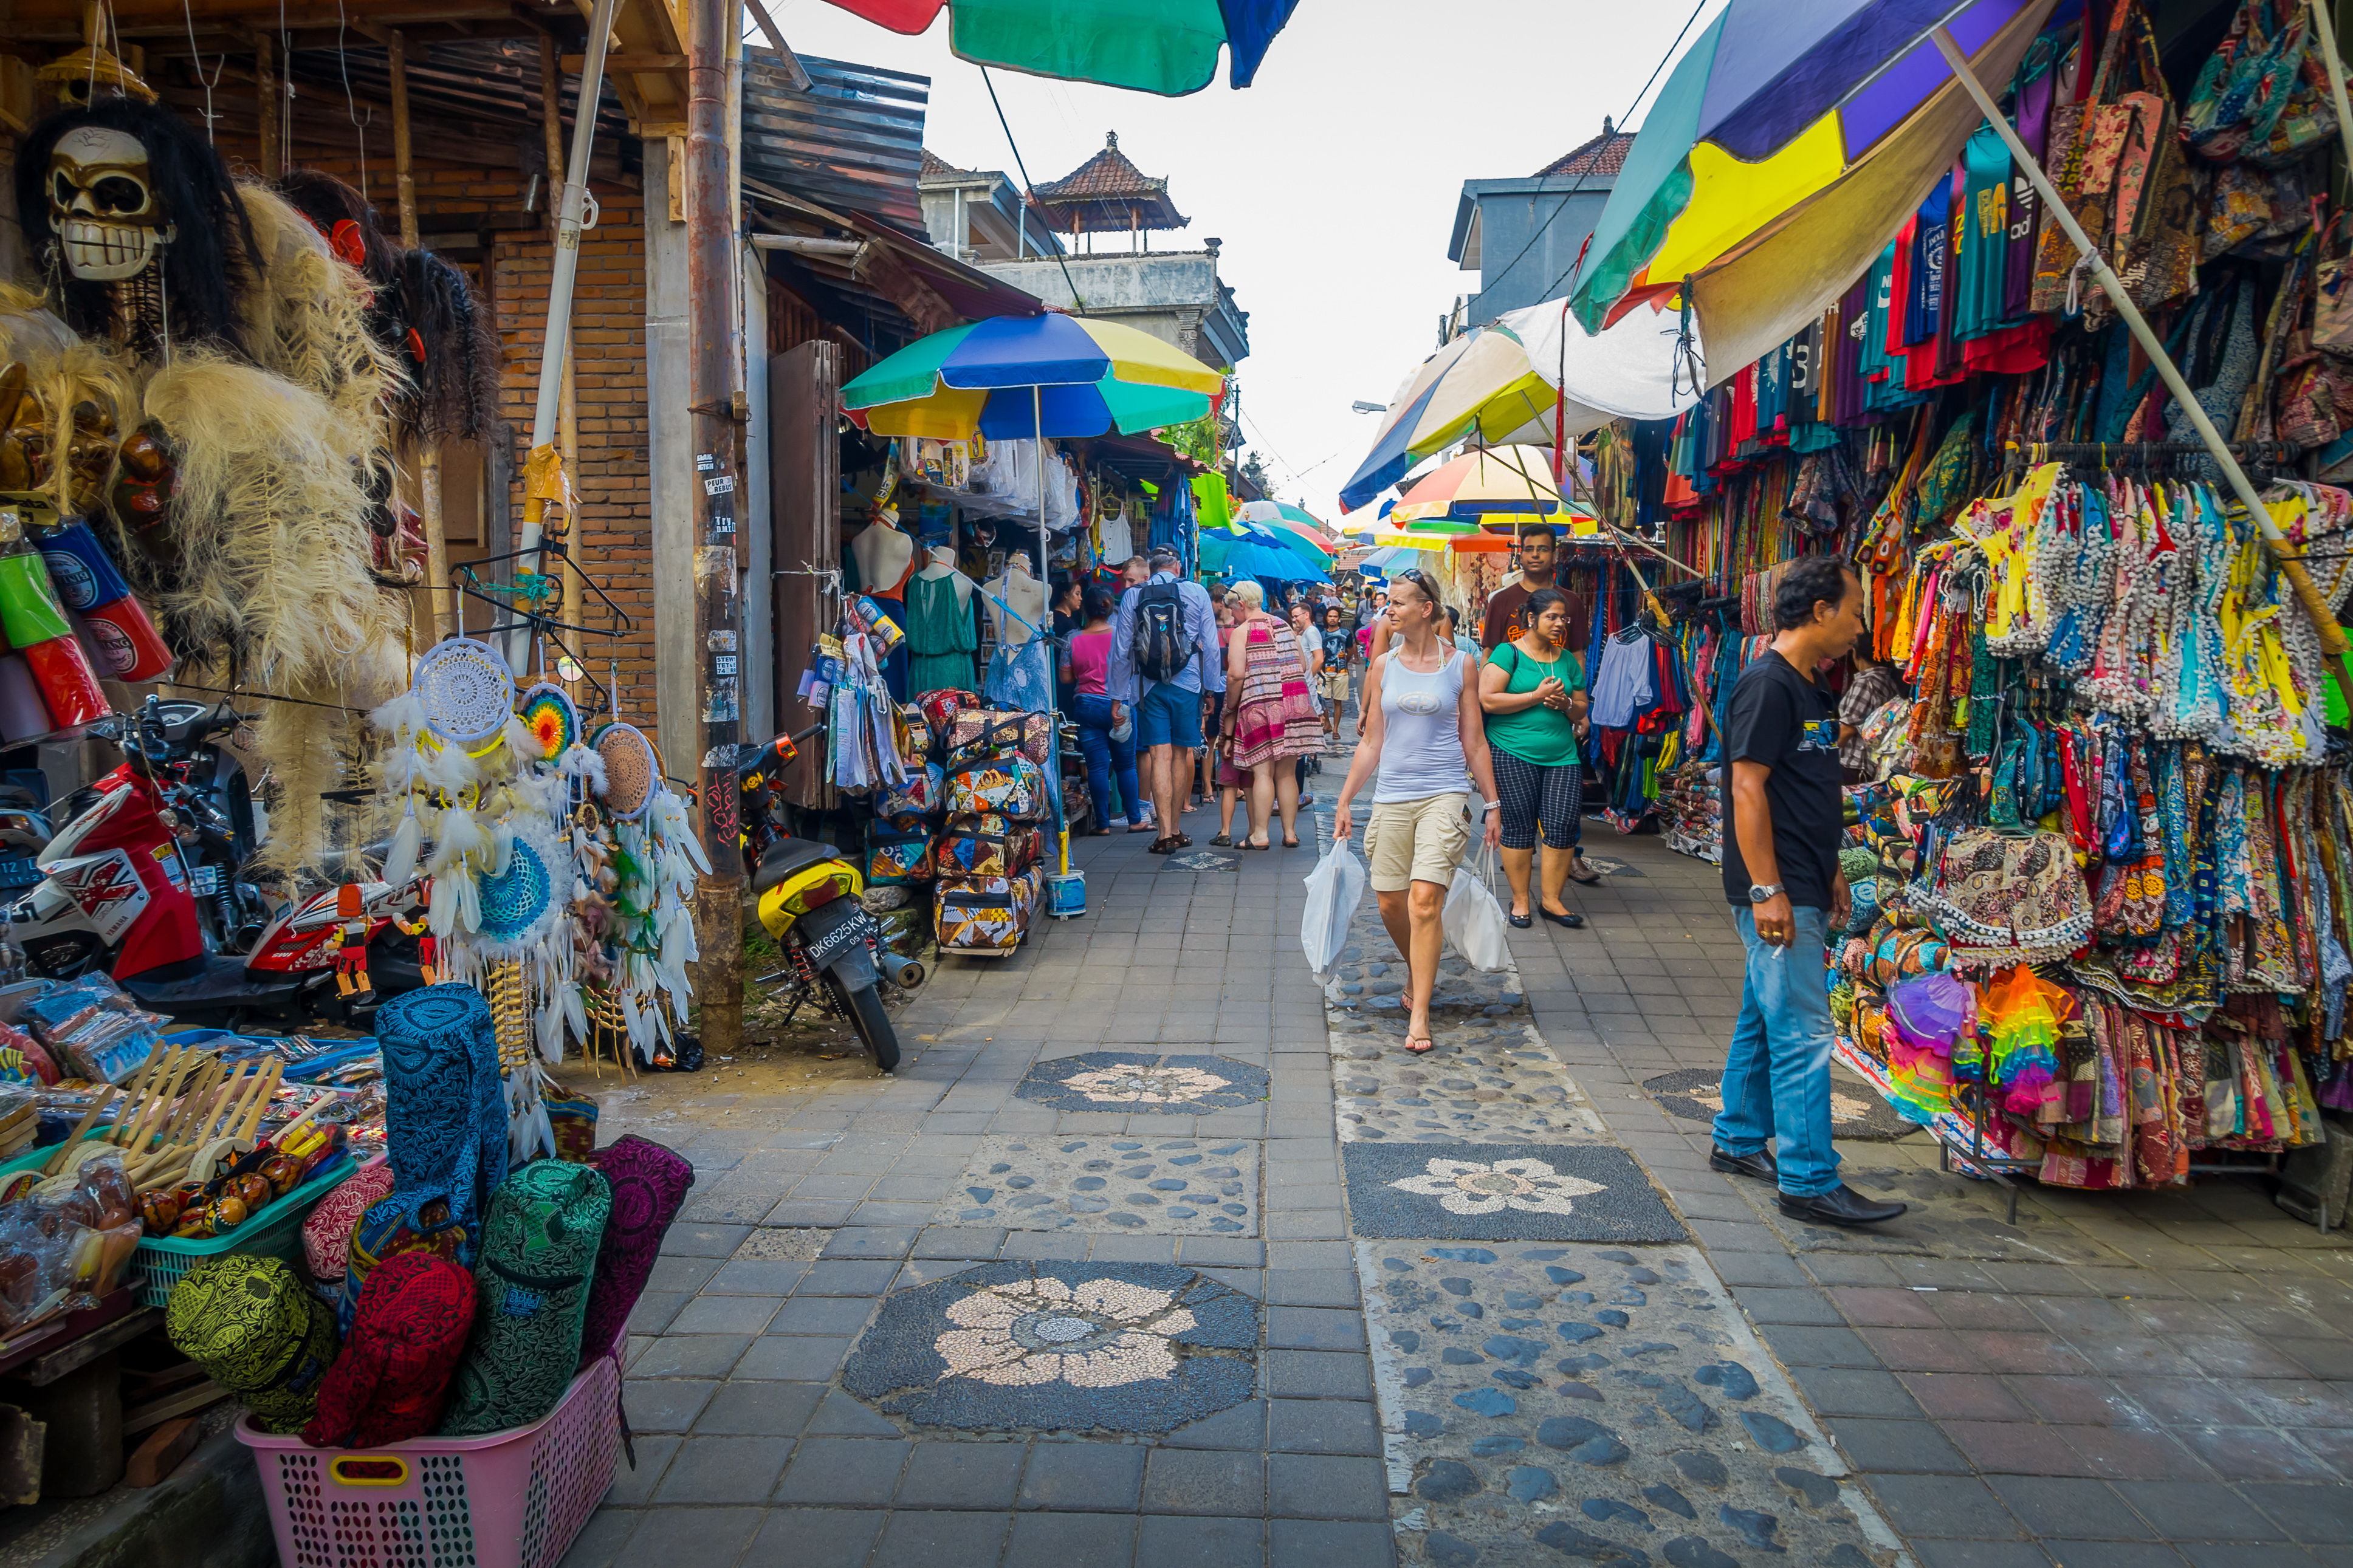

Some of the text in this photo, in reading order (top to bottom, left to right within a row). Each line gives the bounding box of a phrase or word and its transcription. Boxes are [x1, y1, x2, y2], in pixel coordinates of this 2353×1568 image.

[707, 479, 724, 487] PEUR
[714, 484, 732, 493] REBUS
[105, 916, 129, 936] YAMAHA
[809, 911, 867, 958] DK6625KW
[507, 1290, 540, 1309] BALI
